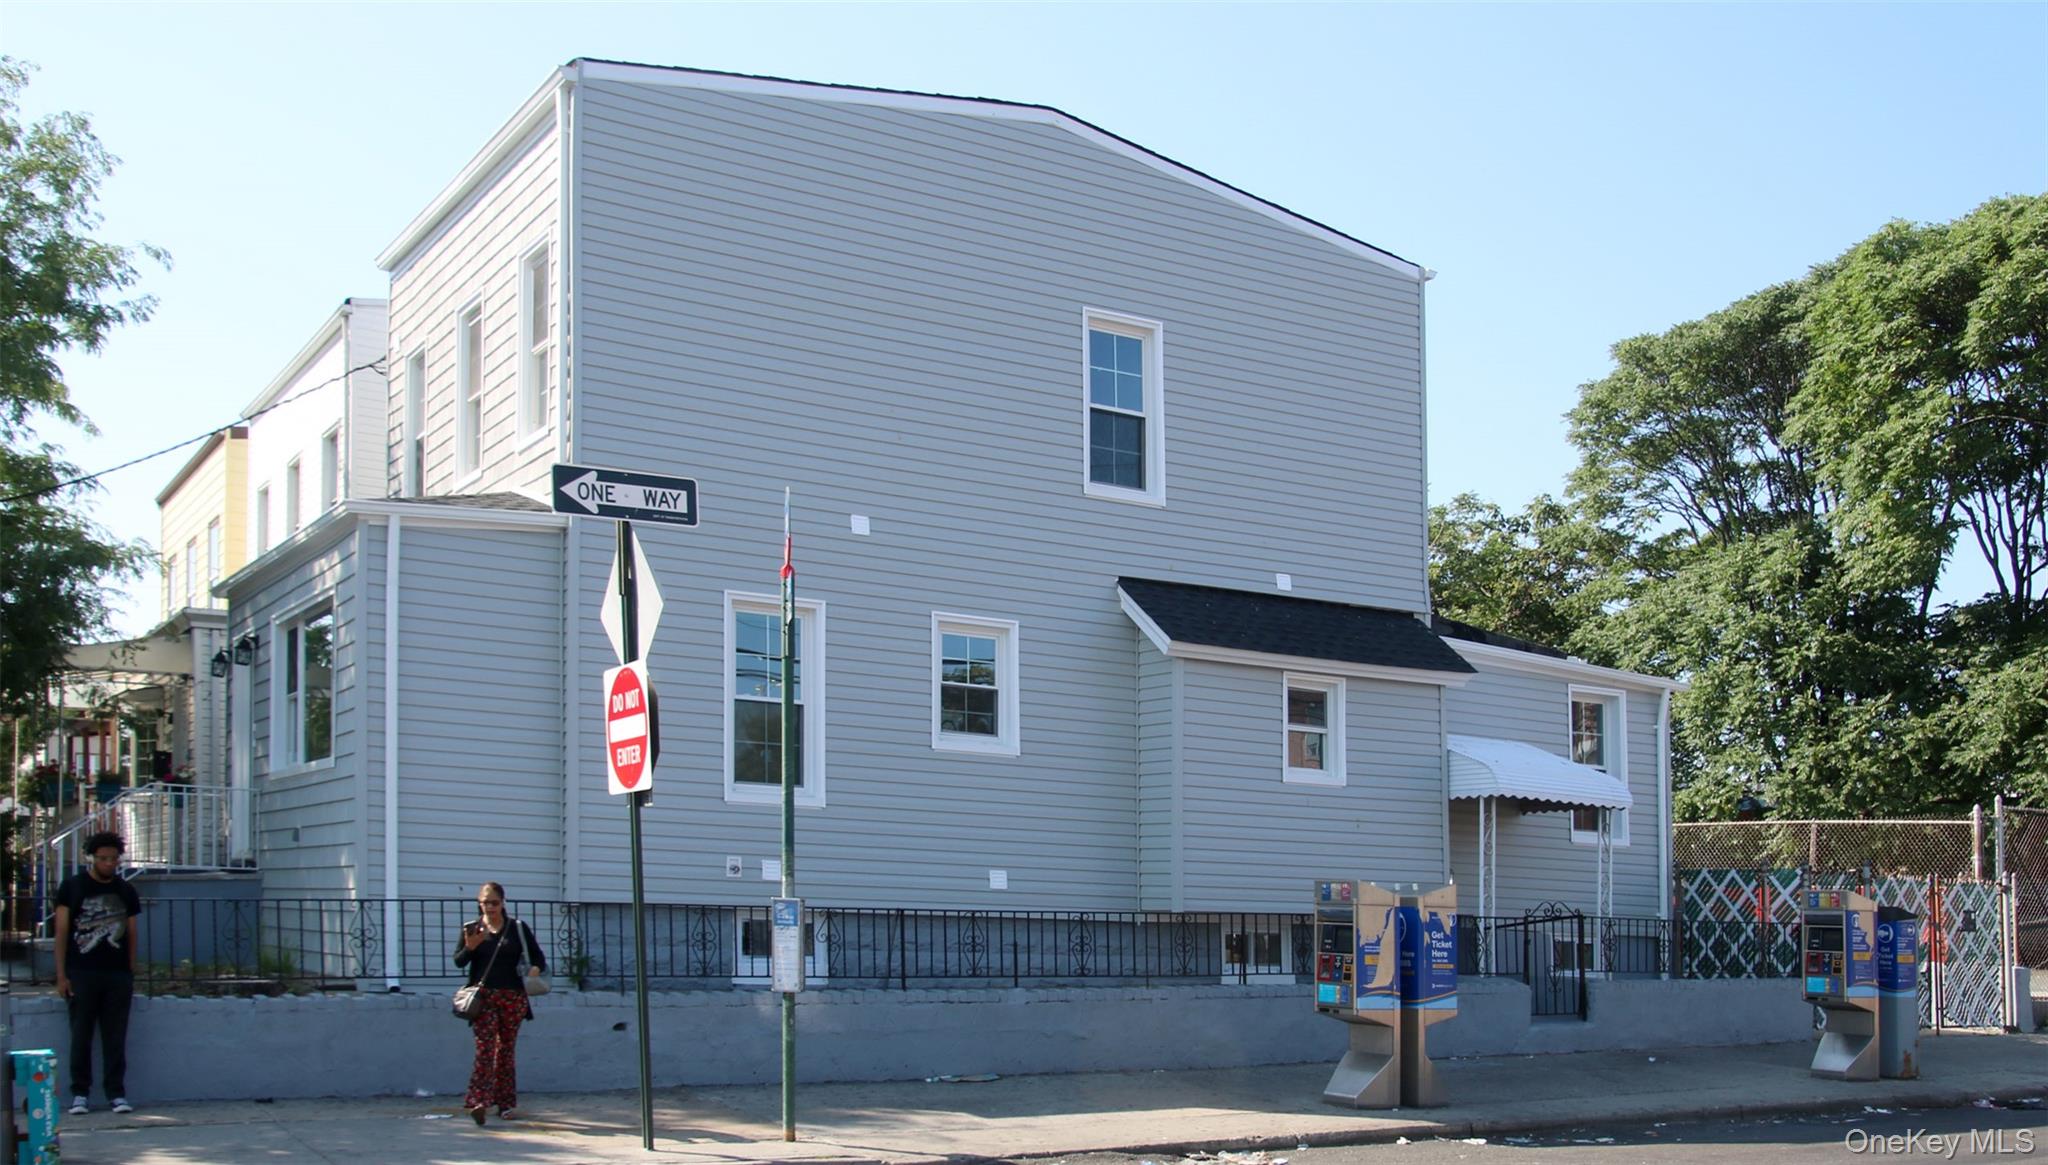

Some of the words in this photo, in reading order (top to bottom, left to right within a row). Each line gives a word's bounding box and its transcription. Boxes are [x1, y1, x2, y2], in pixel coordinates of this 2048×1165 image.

[577, 481, 616, 503] ONE
[643, 489, 682, 510] WAY
[612, 693, 624, 714] DO
[624, 688, 640, 710] NOT
[616, 744, 641, 767] ENTER
[1431, 930, 1445, 939] Get
[1431, 940, 1453, 949] Ticket
[1431, 949, 1448, 958] Here
